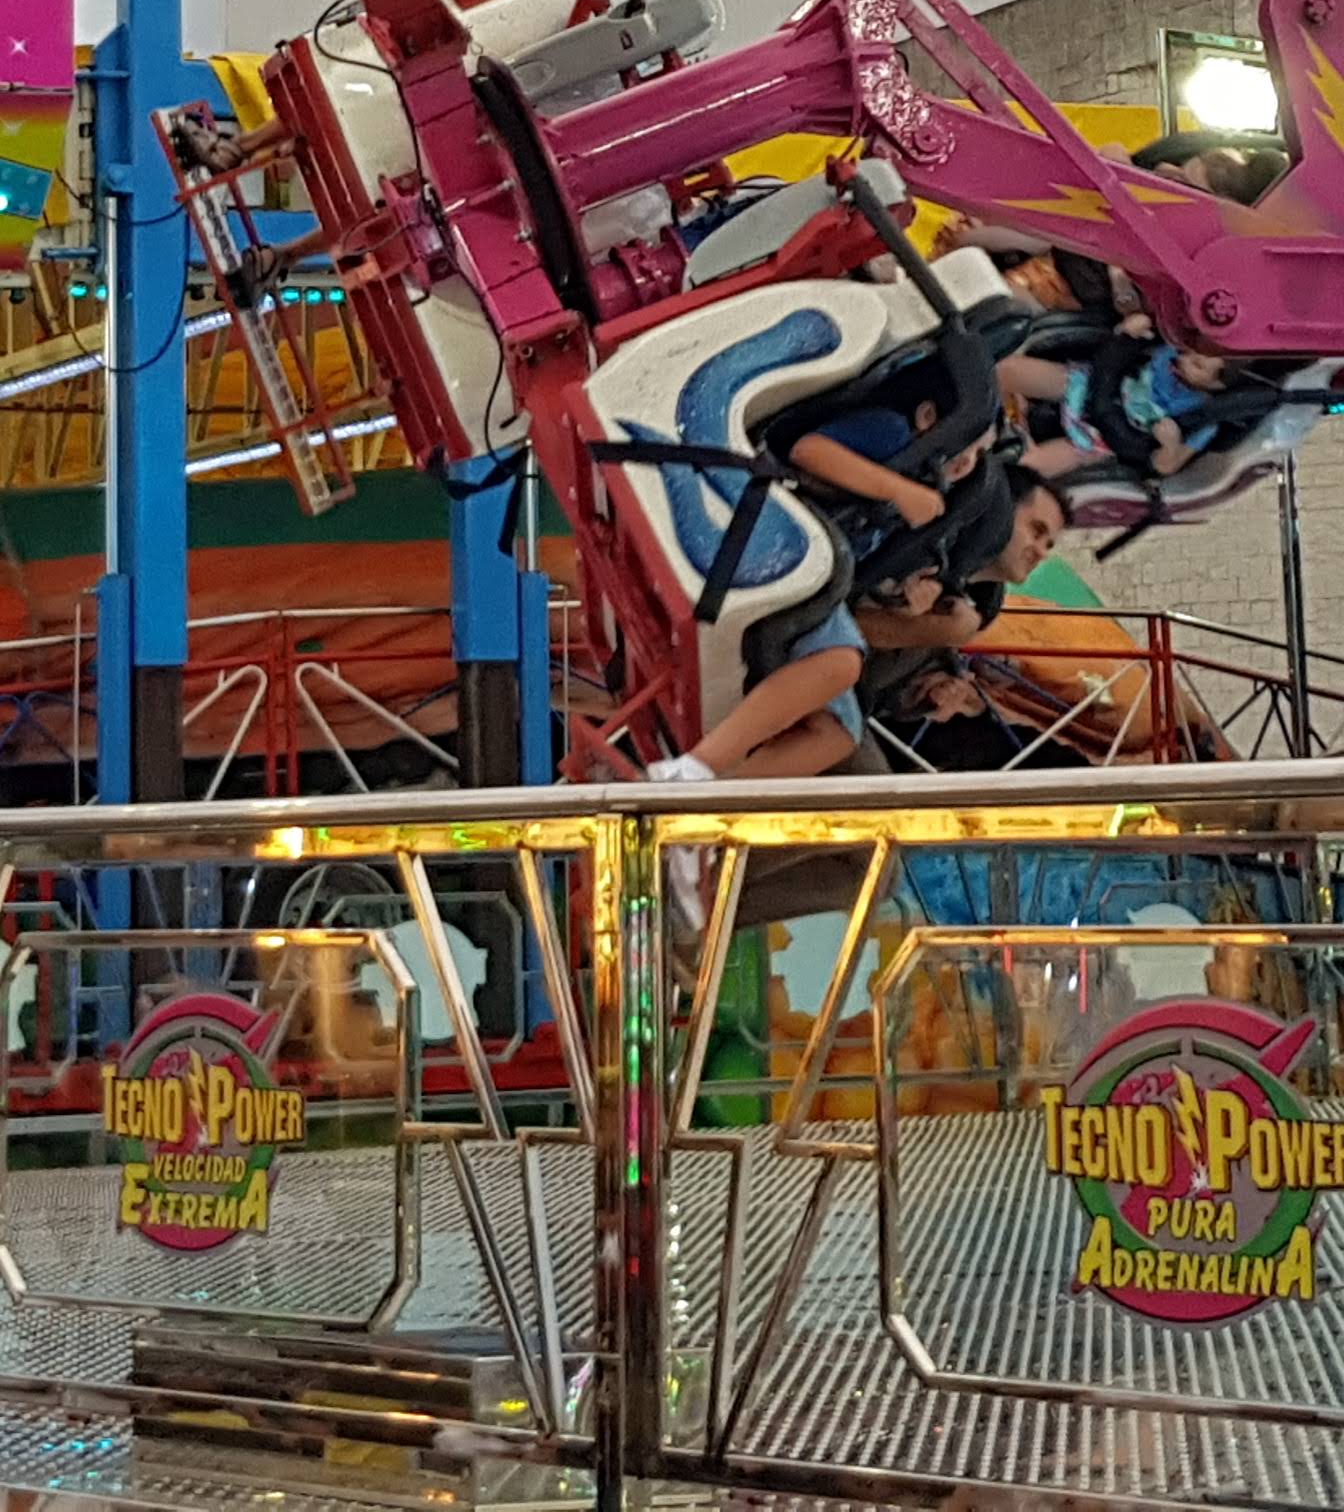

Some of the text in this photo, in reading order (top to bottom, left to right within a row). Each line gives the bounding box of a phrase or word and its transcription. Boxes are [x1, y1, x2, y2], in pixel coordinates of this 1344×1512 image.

[101, 1065, 304, 1145] TECNO POWER
[1041, 1086, 1172, 1186] TECNO
[121, 1164, 269, 1230] EXTREMA
[153, 1152, 247, 1185] VELOCIDAD
[1146, 1198, 1237, 1243] PURA
[1078, 1215, 1316, 1301] ADRENALINA
